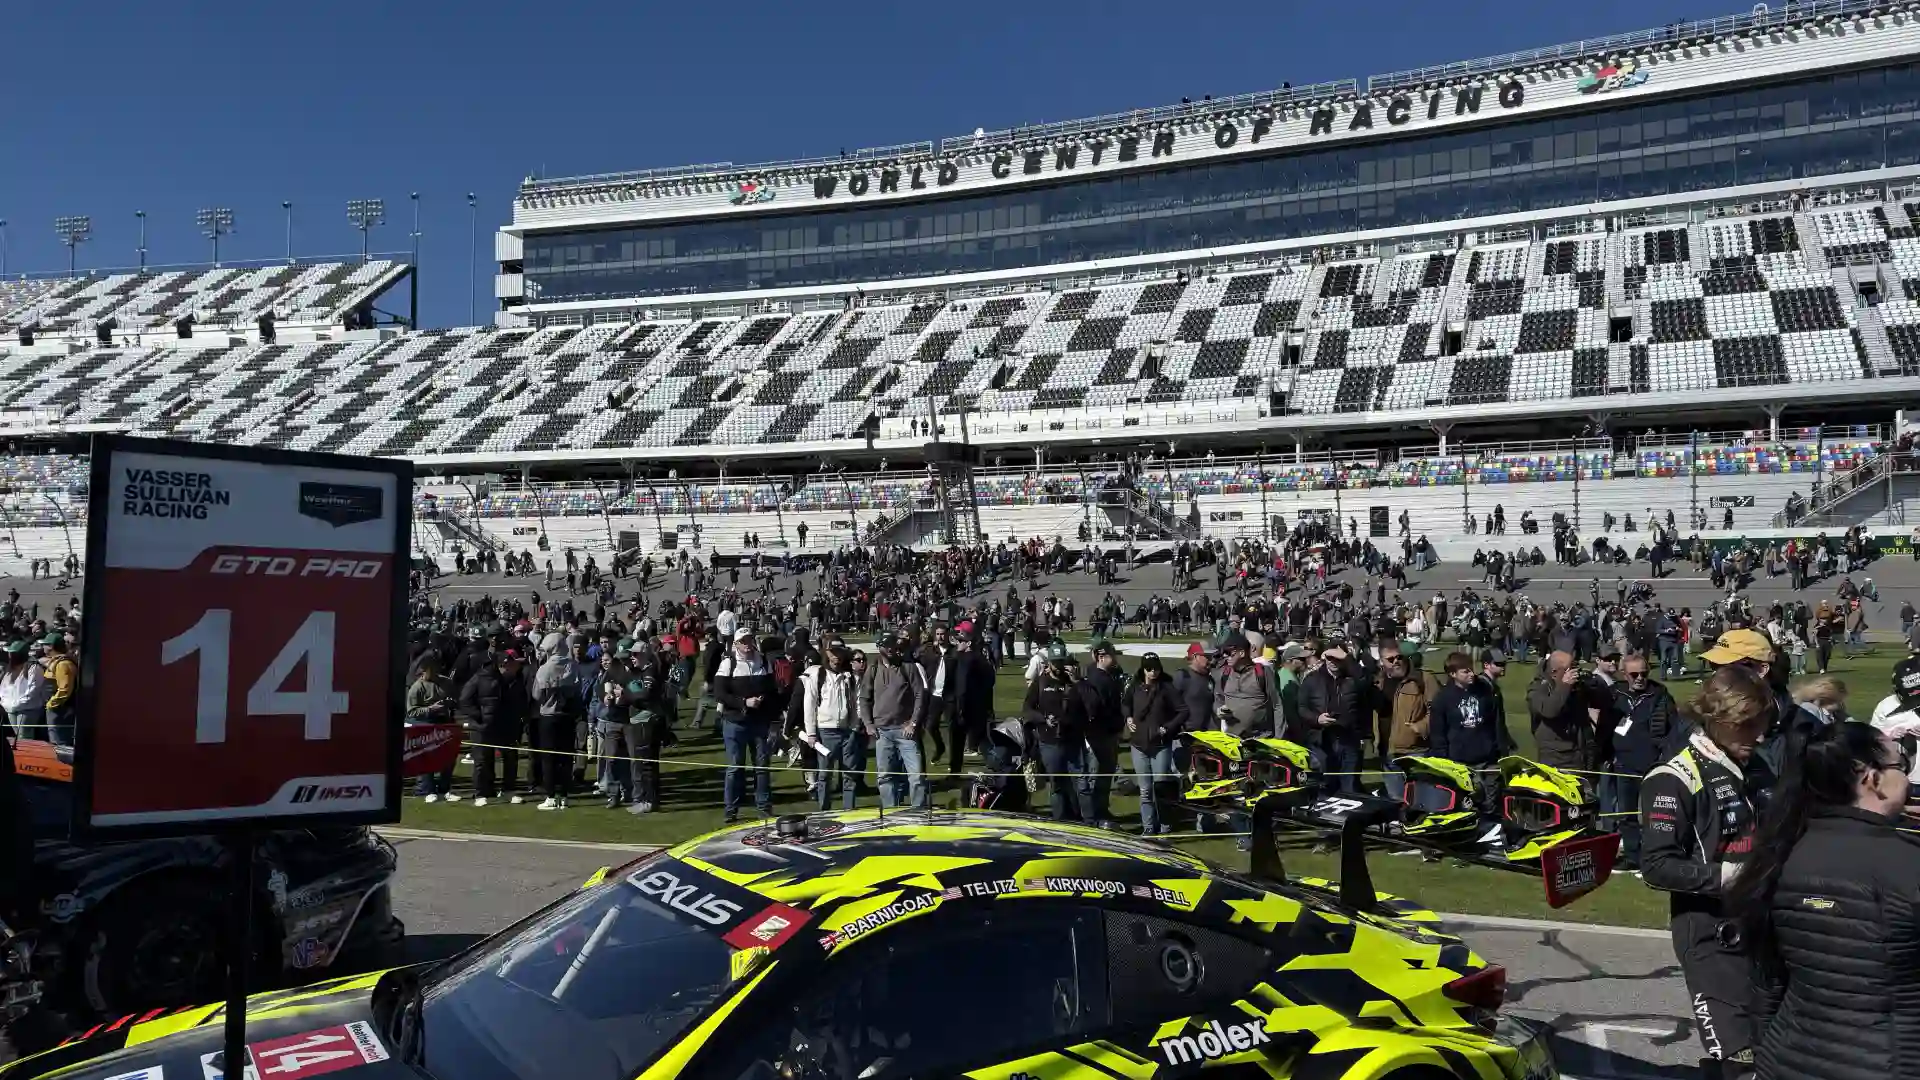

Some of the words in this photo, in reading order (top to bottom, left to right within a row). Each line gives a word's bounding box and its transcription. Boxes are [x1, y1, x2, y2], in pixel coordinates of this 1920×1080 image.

[814, 162, 958, 199] WORLD
[992, 131, 1174, 180] CENTER
[1215, 117, 1274, 149] OF
[1310, 81, 1526, 136] RACING
[1733, 438, 1746, 449] 143
[125, 468, 212, 489] VASSER
[124, 484, 231, 506] SULLIVAN
[123, 501, 208, 520] RACING
[210, 554, 296, 576] GTD
[301, 558, 383, 579] PRO
[161, 608, 350, 745] 14
[319, 785, 373, 800] IMSA
[963, 879, 1019, 897] TELITZ
[1046, 877, 1126, 895] KIRKWOOD
[1556, 865, 1597, 891] SULLIVAN
[626, 866, 744, 926] LEXUS
[1154, 888, 1191, 906] BELL
[843, 892, 936, 939] BARNICOAT
[1693, 992, 1722, 1061] ULLIVAN
[253, 1033, 355, 1075] 14
[349, 1022, 386, 1061] WeatherTech
[1161, 1019, 1271, 1065] molex
